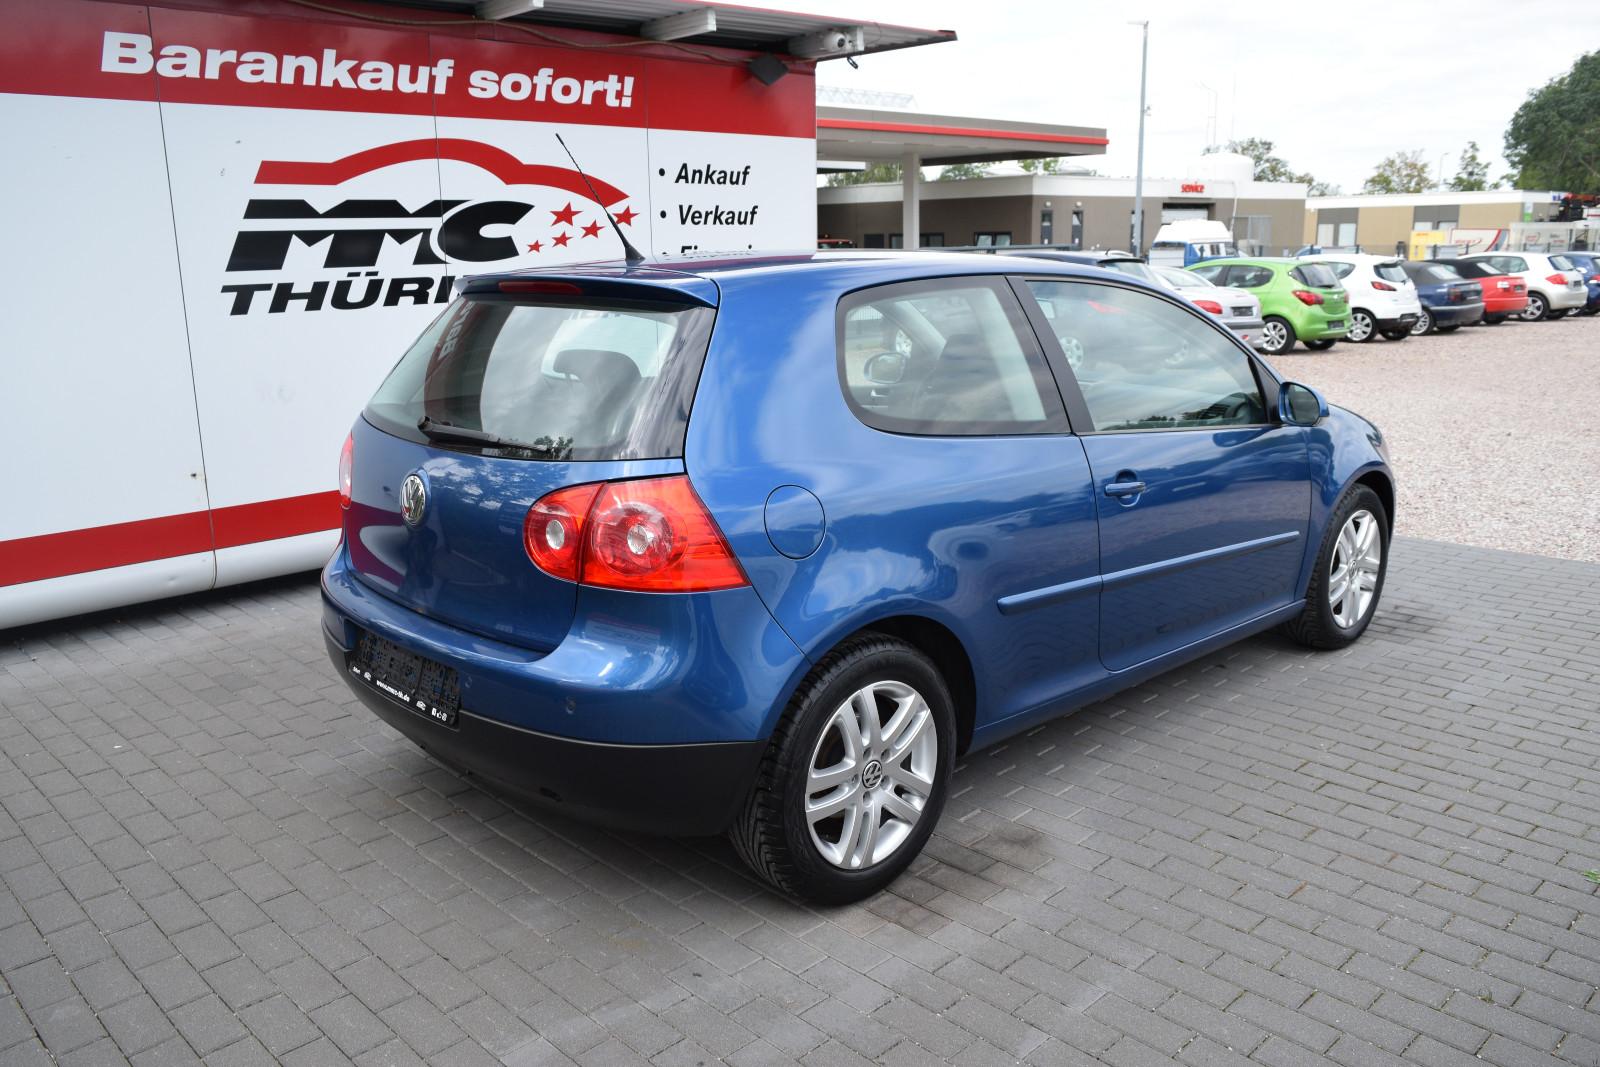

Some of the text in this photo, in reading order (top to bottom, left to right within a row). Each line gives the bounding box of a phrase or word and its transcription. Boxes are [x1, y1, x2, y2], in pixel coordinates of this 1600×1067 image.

[100, 31, 635, 108] Barankauf sofort!
[674, 162, 751, 186] Ankauf
[225, 199, 535, 271] MMC
[678, 204, 759, 226] Verkauf
[220, 271, 456, 316] THÜRI
